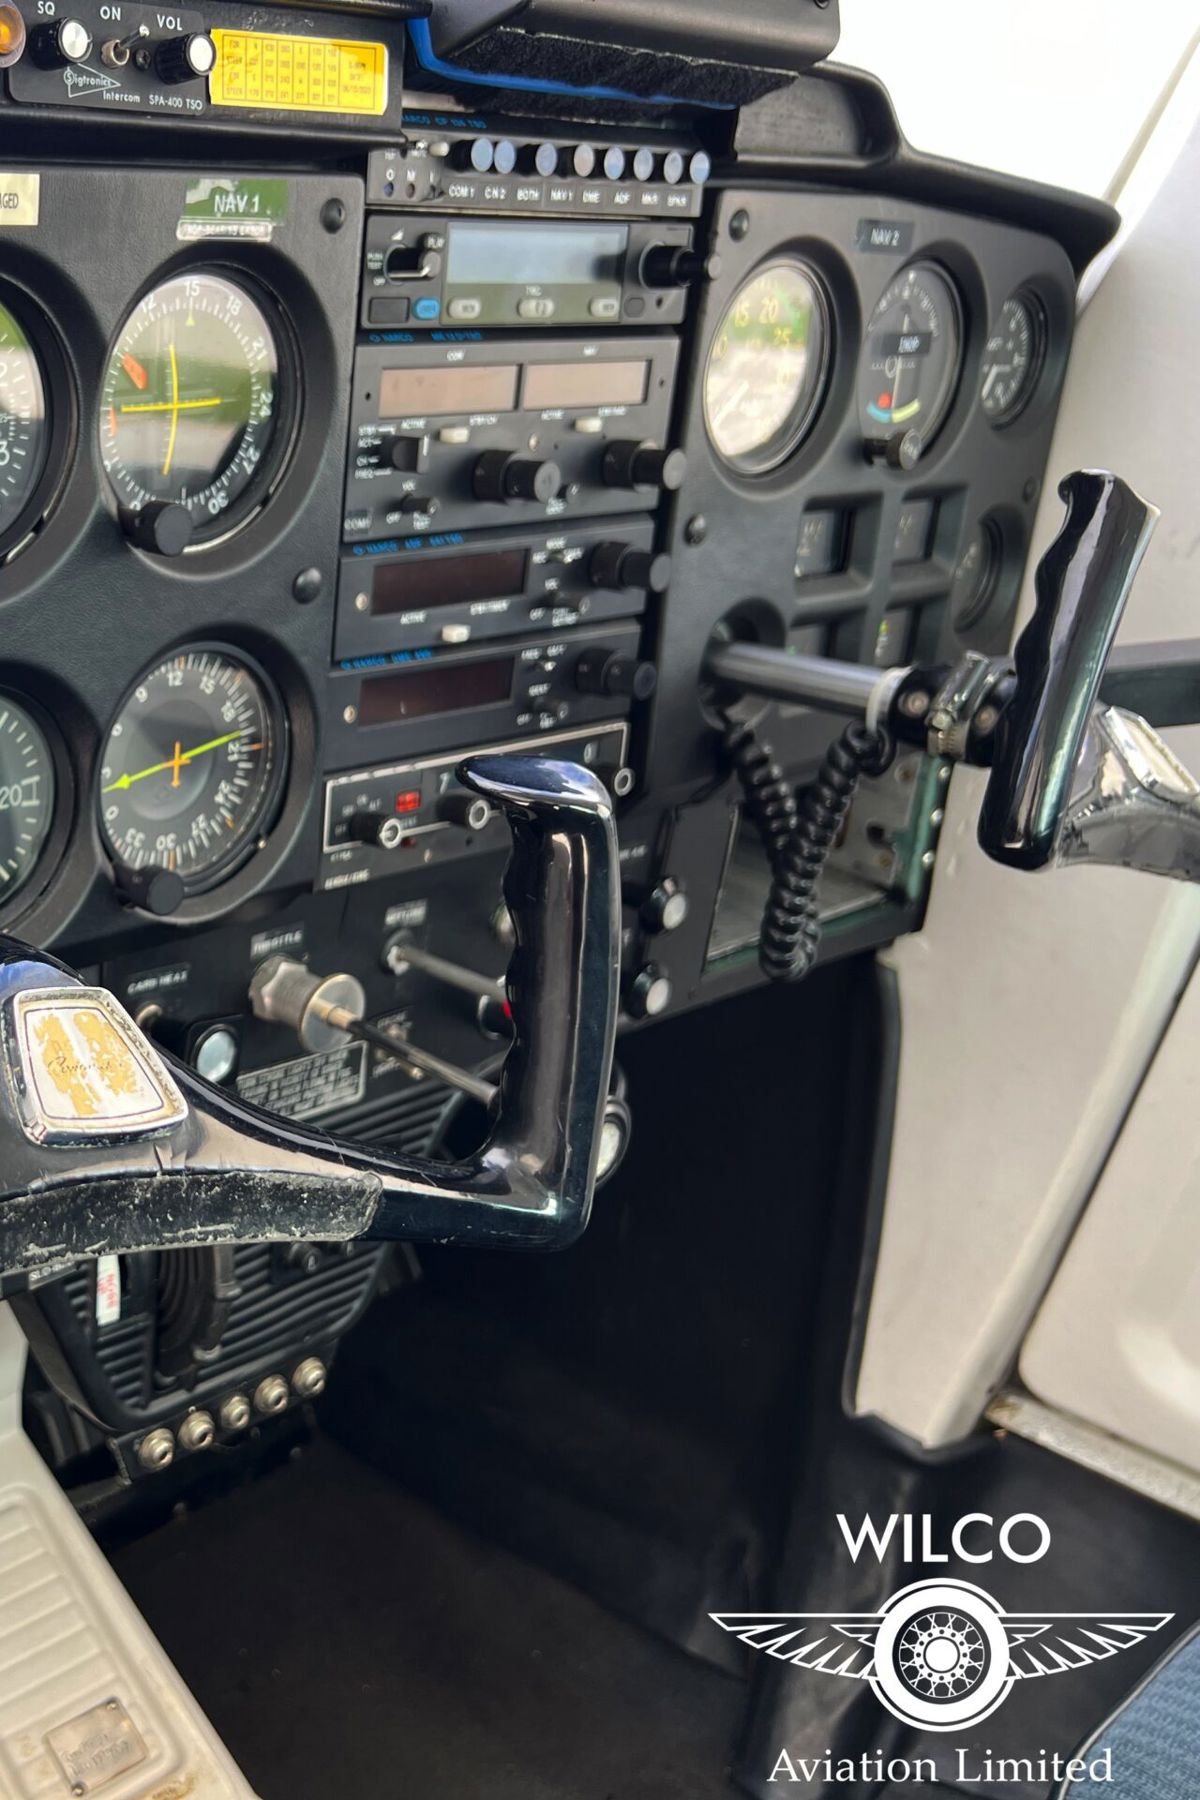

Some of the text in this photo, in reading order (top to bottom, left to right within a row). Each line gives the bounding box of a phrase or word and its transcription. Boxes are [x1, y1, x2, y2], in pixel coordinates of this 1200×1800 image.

[37, 1, 55, 16] SQ
[100, 5, 121, 21] ON
[157, 14, 183, 31] VOL
[63, 69, 112, 87] Sigtronics
[102, 90, 203, 111] Intercom SPA-400 TSO
[214, 194, 260, 213] NAV 1
[870, 226, 892, 245] NAV
[183, 280, 201, 297] 15
[139, 293, 157, 313] 12
[225, 295, 243, 316] 18
[251, 336, 269, 361] 21
[259, 391, 274, 418] 24
[242, 447, 261, 475] 27
[207, 490, 230, 515] 30
[166, 670, 184, 687] 12
[198, 676, 217, 695] 15
[124, 826, 146, 849] 33
[155, 833, 178, 849] 30
